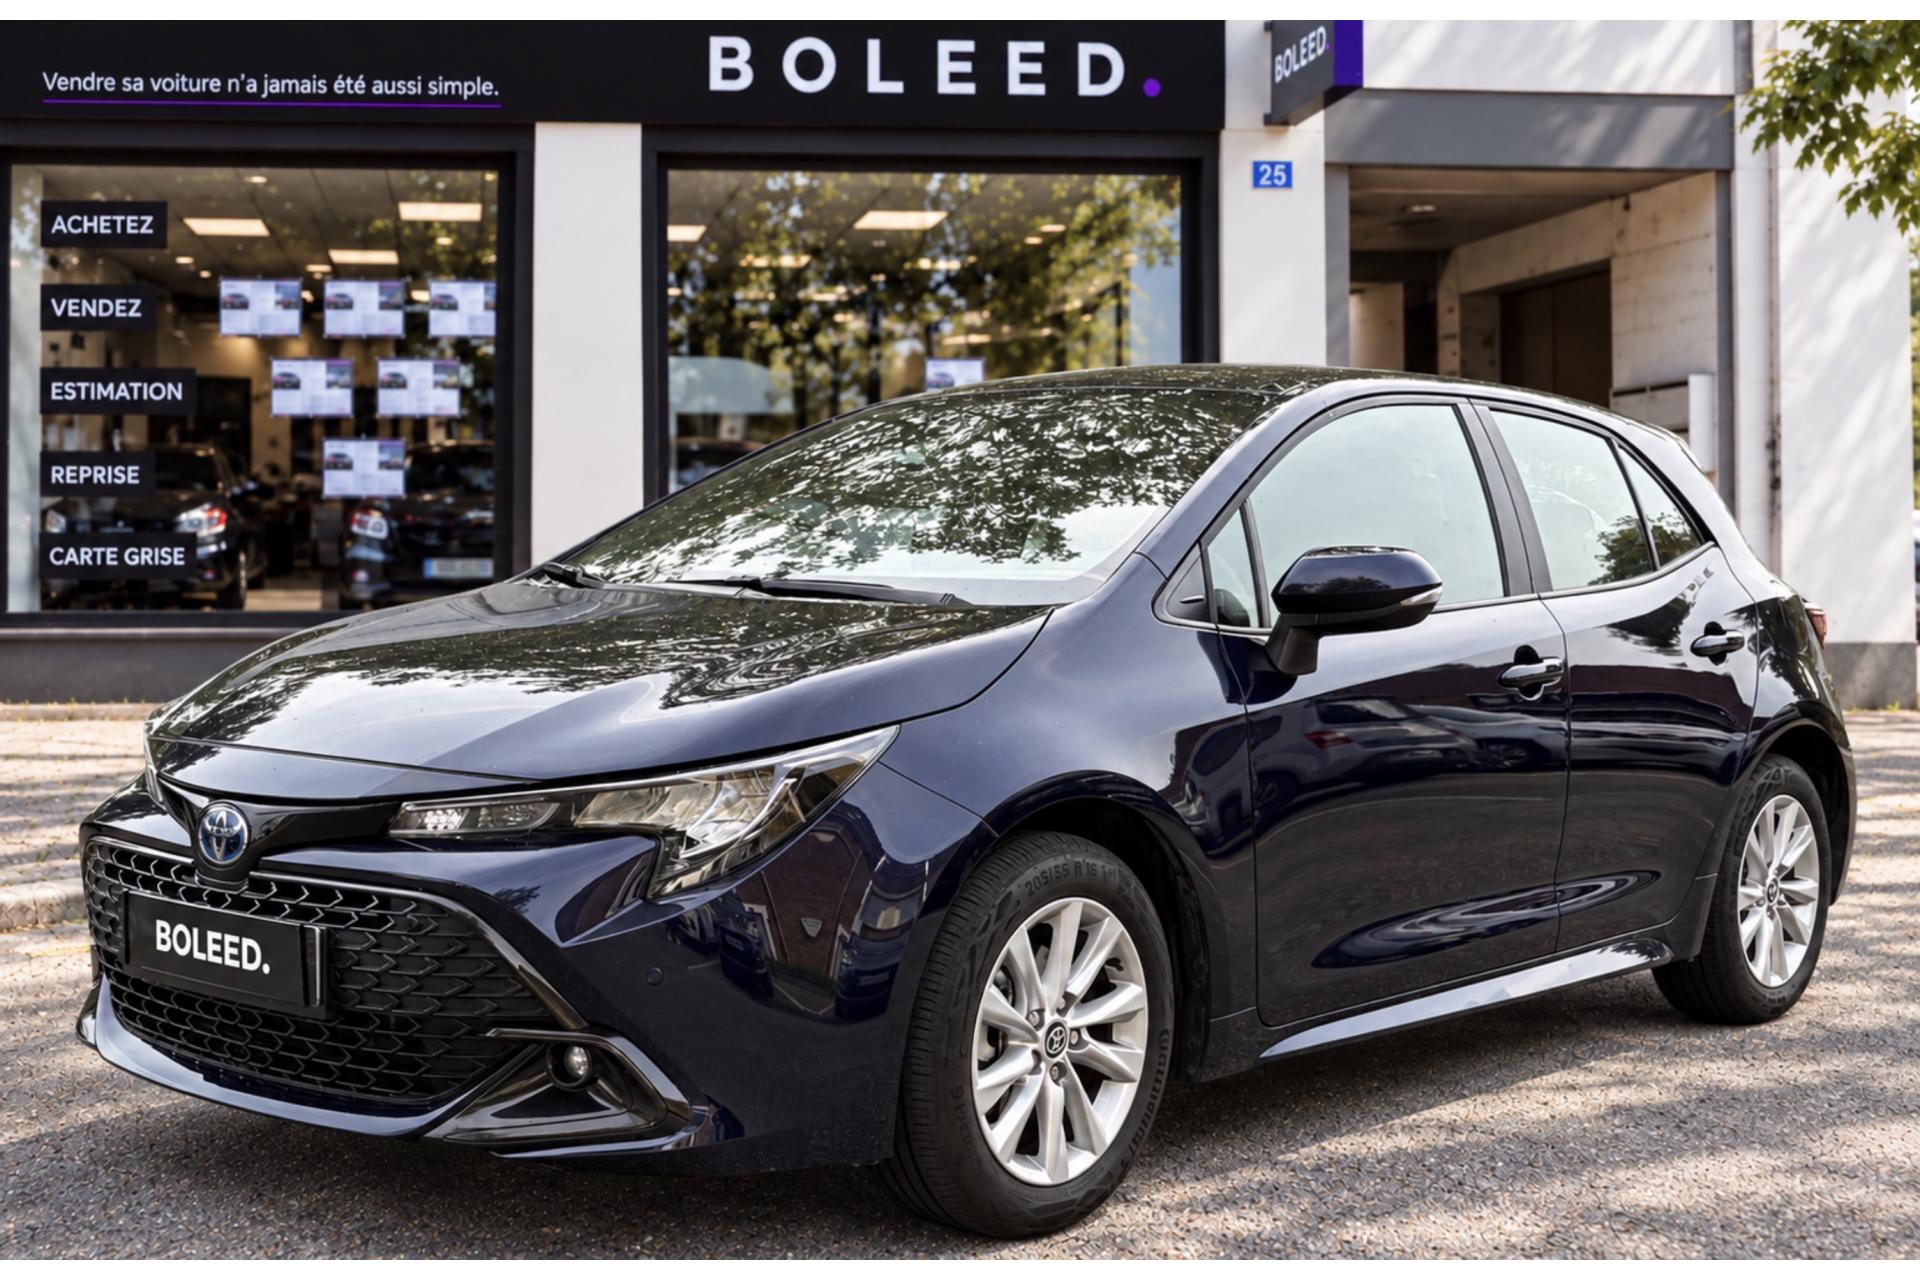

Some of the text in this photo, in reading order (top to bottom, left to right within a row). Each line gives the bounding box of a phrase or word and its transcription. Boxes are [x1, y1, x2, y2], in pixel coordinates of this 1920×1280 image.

[709, 35, 1161, 97] BOLEED.
[42, 71, 500, 99] Vendre sa voiture n'a jamais été aussi simple.
[1259, 164, 1287, 185] 25
[51, 214, 154, 235] ACHETEZ
[51, 298, 142, 318] VENDEZ
[51, 381, 183, 402] ESTIMATION
[51, 465, 140, 485] REPRISE
[49, 546, 185, 567] CARTE GRISE
[155, 918, 271, 975] BOLEED.
